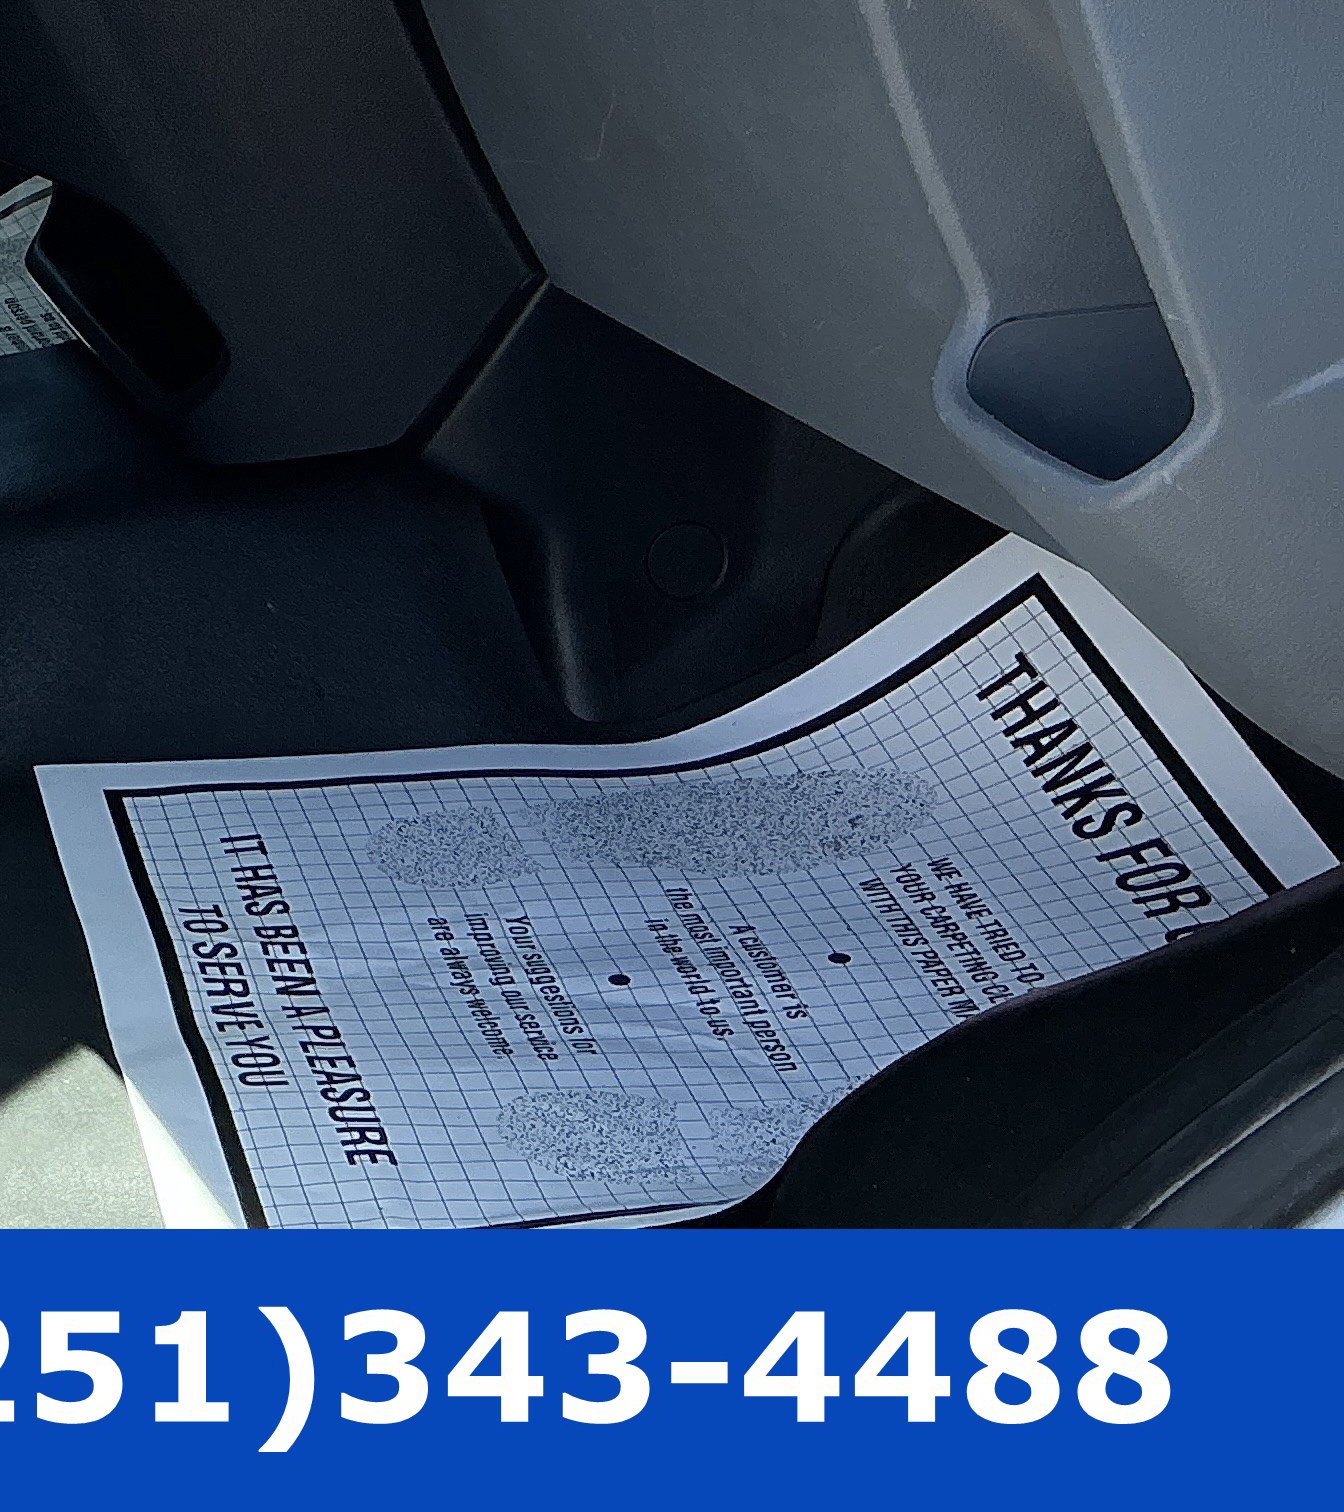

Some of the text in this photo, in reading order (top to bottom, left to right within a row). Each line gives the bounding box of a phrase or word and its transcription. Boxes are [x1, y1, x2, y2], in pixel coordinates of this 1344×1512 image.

[976, 651, 1212, 919] THANKS FOR
[427, 917, 455, 942] are
[440, 947, 481, 997] always
[644, 918, 670, 932] in
[654, 933, 683, 954] the
[666, 887, 798, 1073] the most important person
[670, 955, 717, 996] world
[728, 925, 809, 1020] A customer is
[859, 877, 903, 914] WITH
[886, 914, 930, 947] THIS
[911, 948, 966, 998] PAPER
[890, 862, 1015, 1004] YOUR CARPETING CL
[927, 857, 1045, 984] WE HAVE TRIED TO
[178, 903, 291, 1087] TO SERVE YOU
[219, 834, 399, 1168] IT HAS BEEN A PLEASURE
[464, 913, 559, 1061] improving our service
[506, 915, 598, 1055] Your suggestions for
[696, 998, 721, 1015] to
